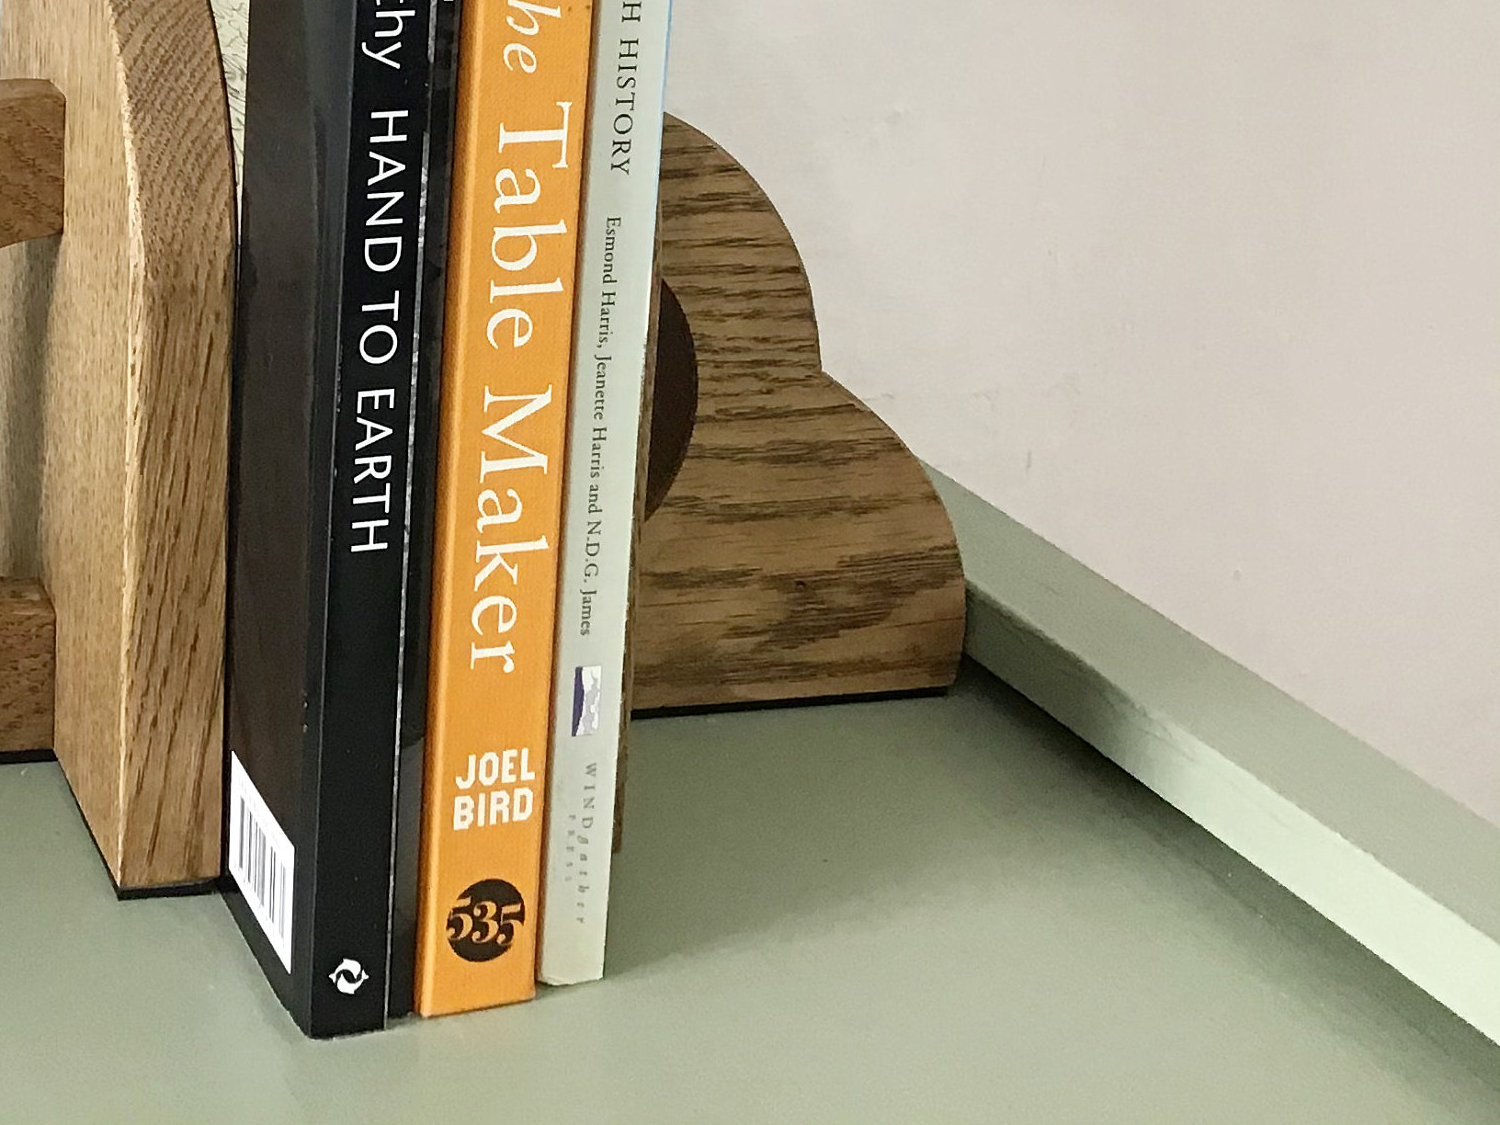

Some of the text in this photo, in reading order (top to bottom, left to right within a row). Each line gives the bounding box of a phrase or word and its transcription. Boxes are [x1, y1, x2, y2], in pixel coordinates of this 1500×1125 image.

[610, 37, 639, 175] HISTORY
[363, 108, 409, 272] HAND
[486, 100, 573, 350] Table
[359, 289, 399, 365] TO
[349, 387, 395, 553] EARTH
[579, 216, 622, 636] Esmond Harris, Jeanette Harris and N.D.G. James
[470, 383, 552, 674] Maker
[453, 787, 534, 831] BIRD
[455, 747, 536, 789] JOEL
[446, 895, 524, 947] 535
